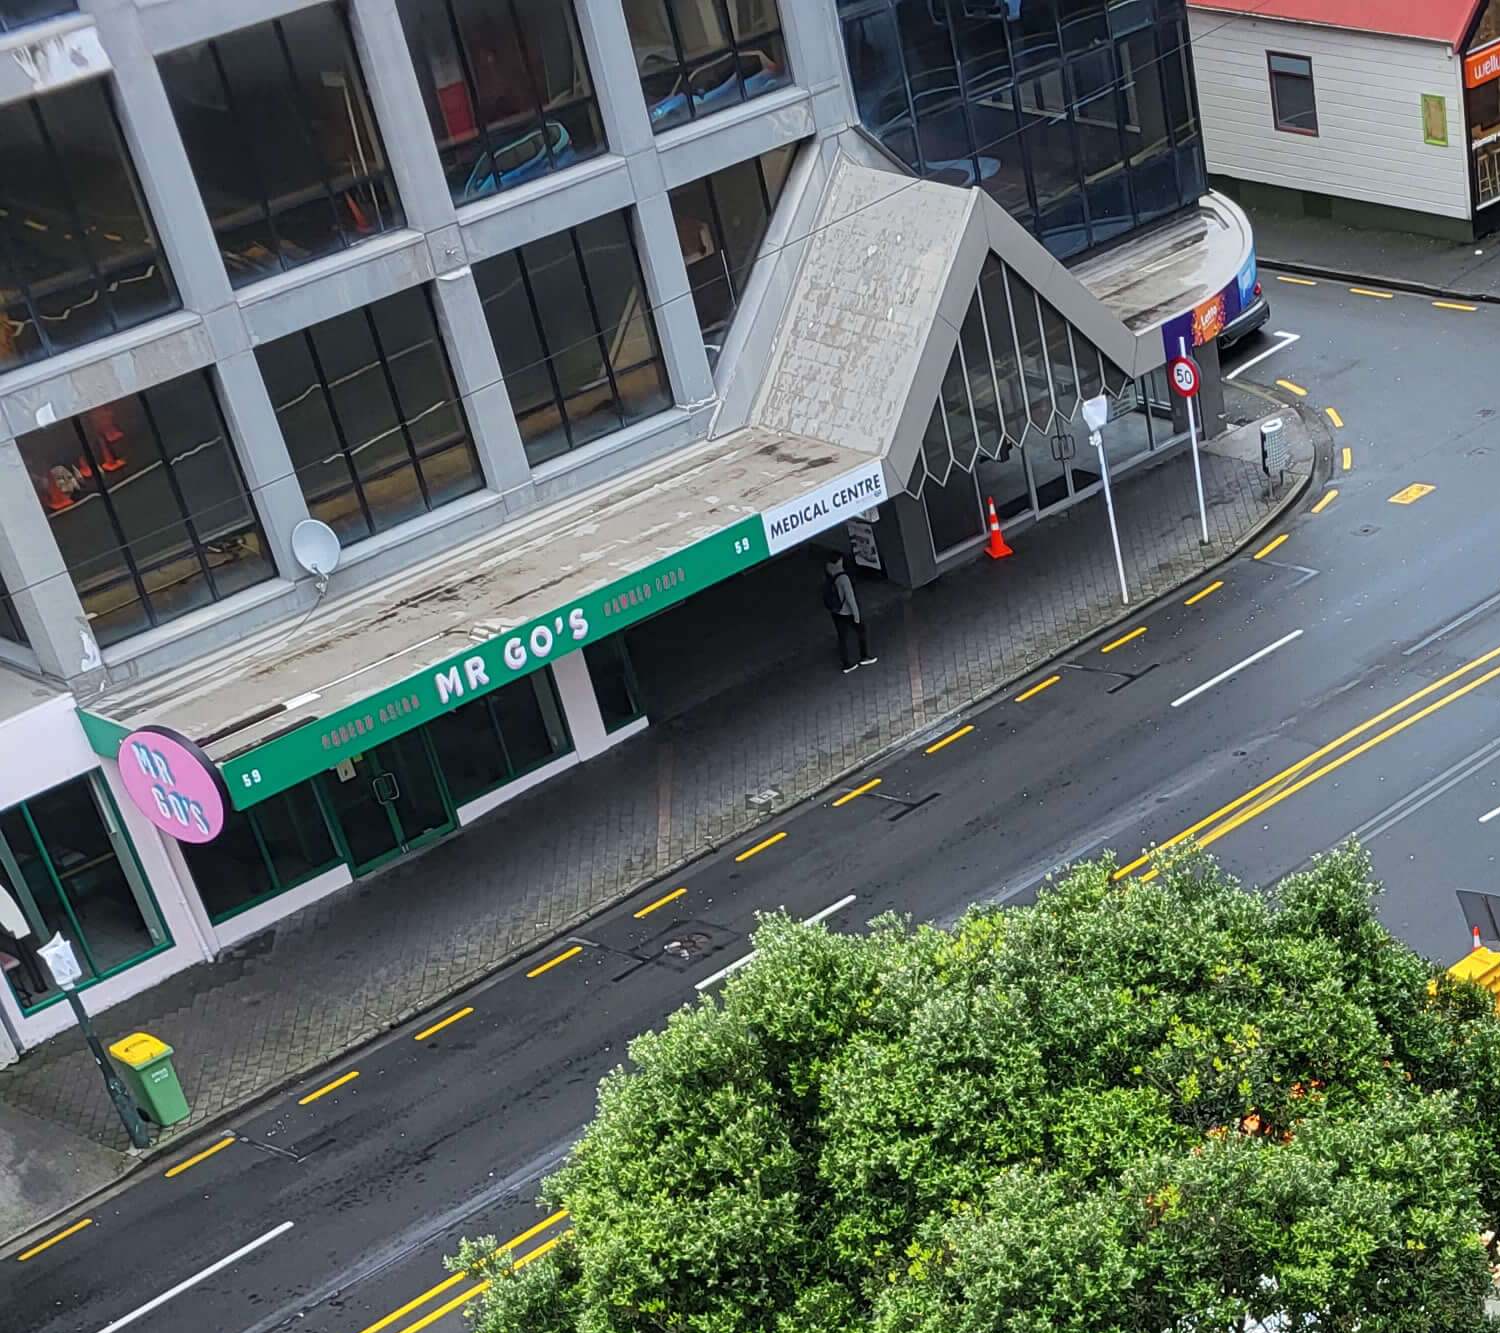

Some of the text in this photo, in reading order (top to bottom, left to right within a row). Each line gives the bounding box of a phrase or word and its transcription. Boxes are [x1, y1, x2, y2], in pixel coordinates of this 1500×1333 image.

[1176, 368, 1193, 385] 50
[770, 473, 881, 539] MEDICAL CENTRE
[733, 537, 750, 554] 59
[434, 607, 589, 704] MR GO'S
[131, 740, 176, 787] MR
[241, 768, 262, 788] 59
